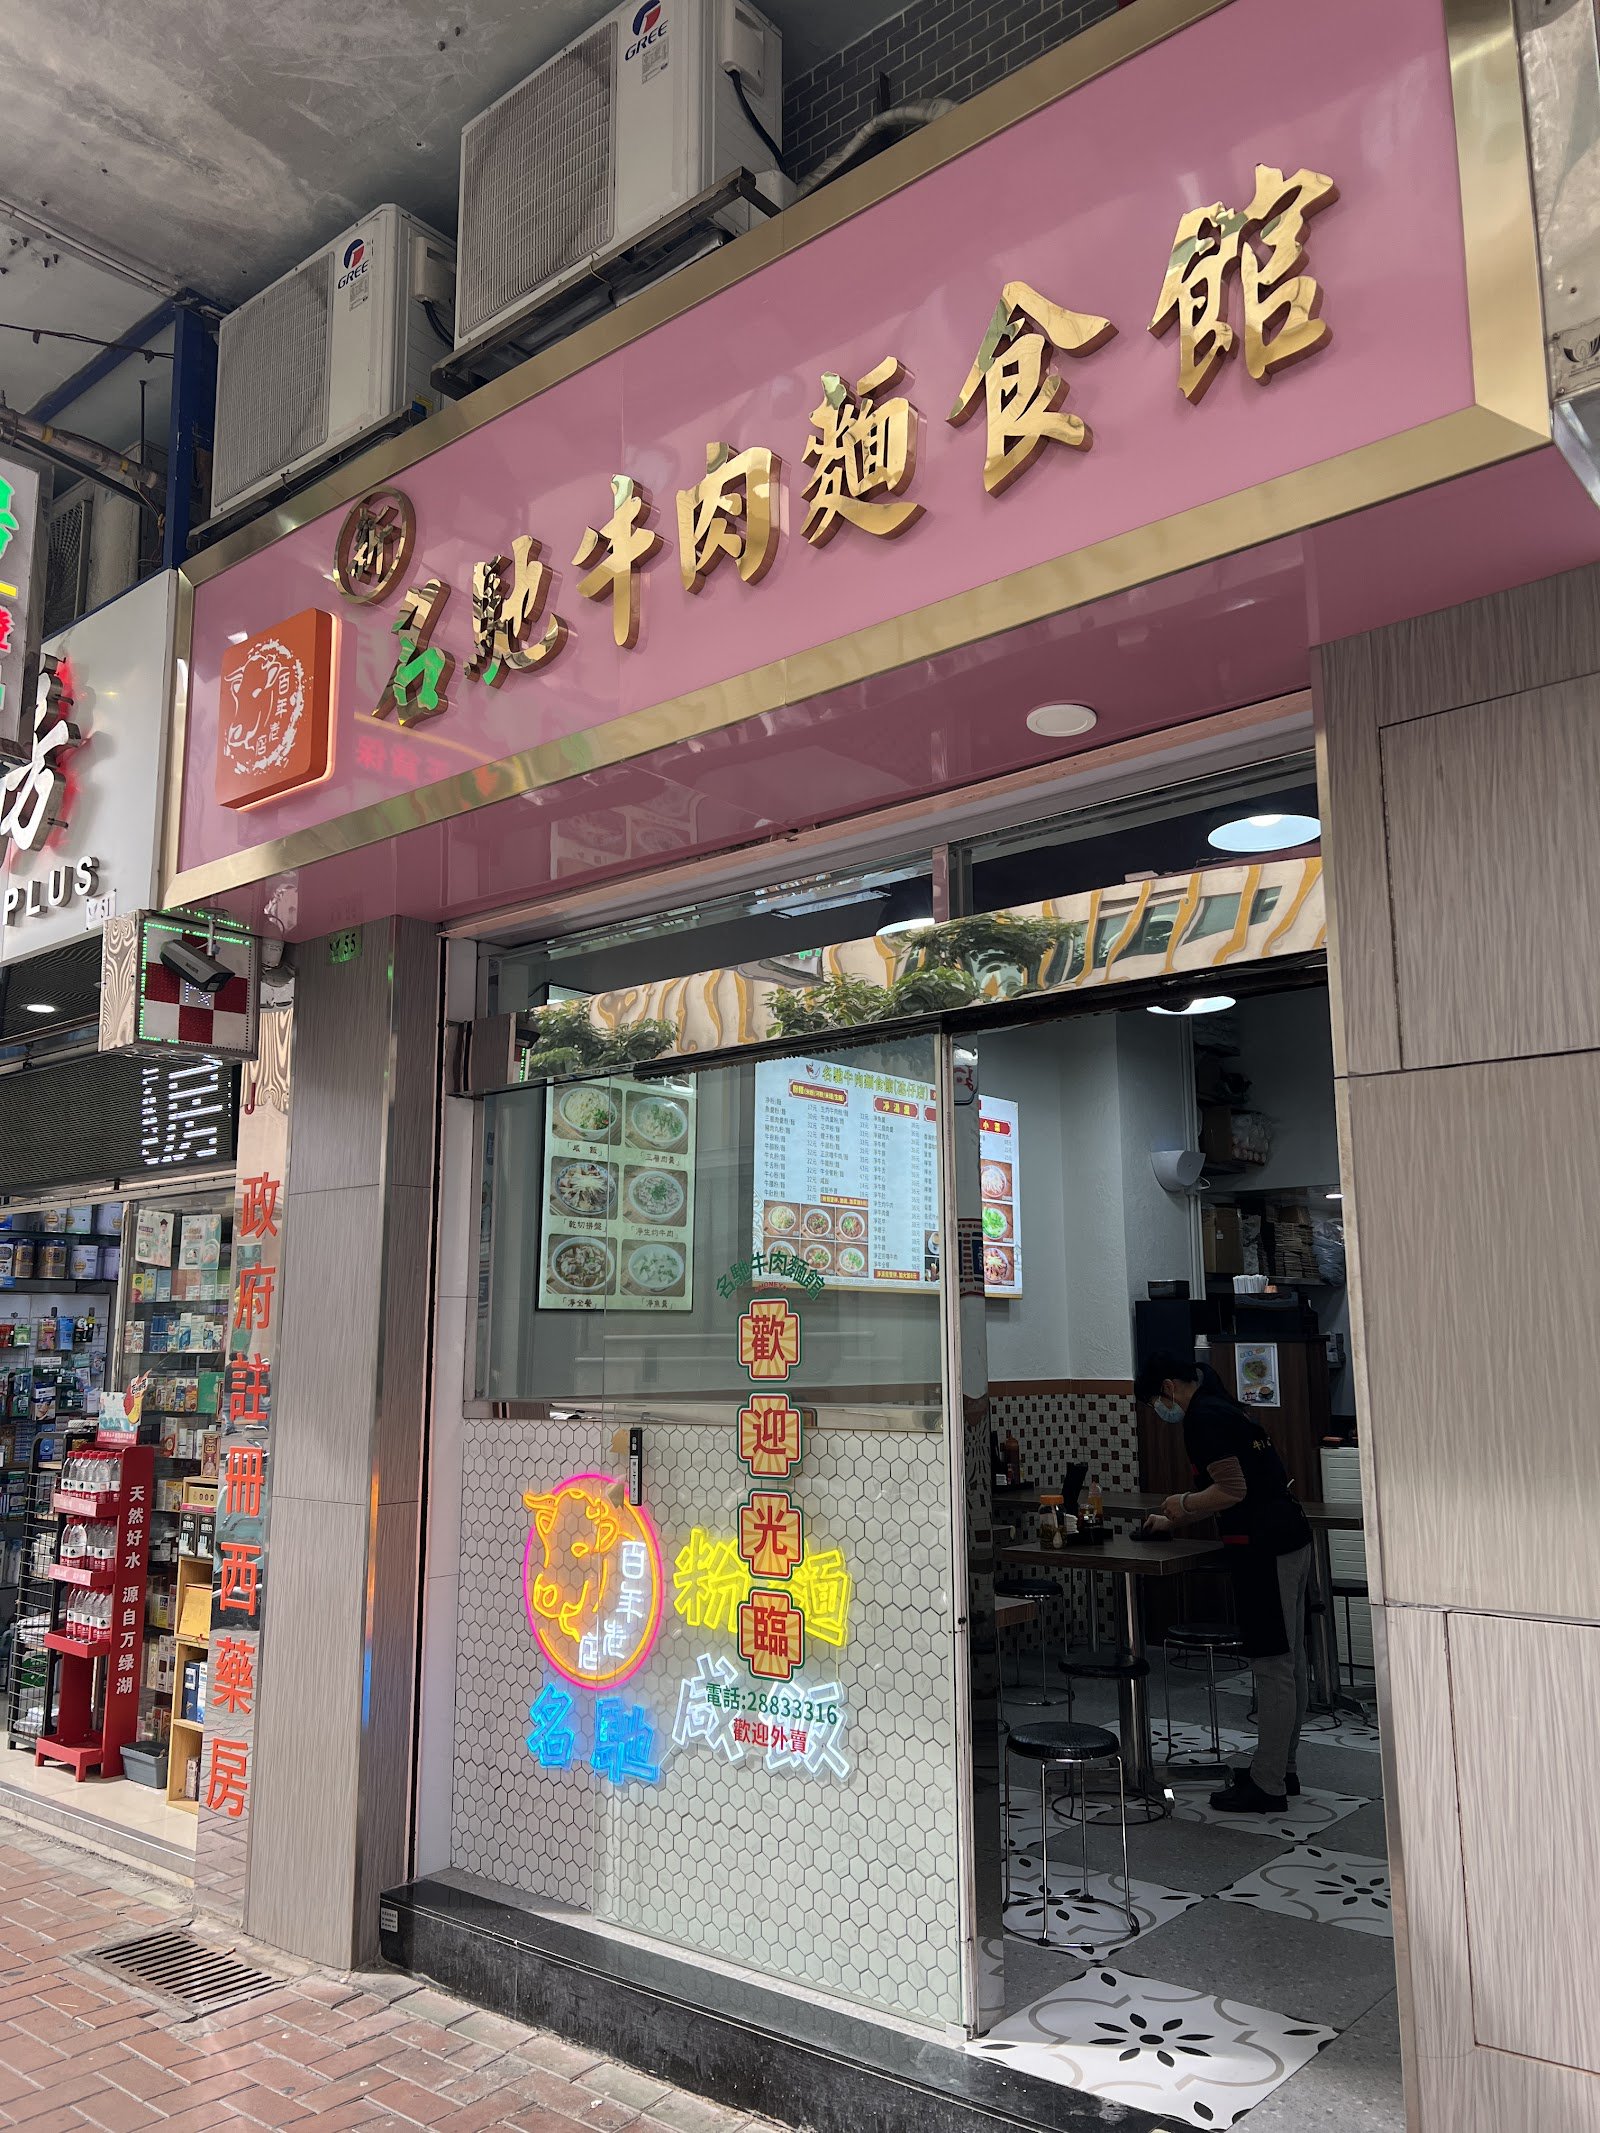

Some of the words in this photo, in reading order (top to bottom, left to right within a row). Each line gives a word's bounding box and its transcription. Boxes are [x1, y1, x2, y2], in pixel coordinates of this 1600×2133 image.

[625, 20, 668, 61] GREE
[338, 259, 369, 289] GREE
[3, 856, 99, 926] PLUS
[716, 1251, 826, 1300] 名馳牛肉麵館
[205, 1170, 280, 1818] 政府註冊西藥房
[751, 1314, 790, 1657] 歡迎光臨
[124, 1485, 146, 1570] 天然好水
[116, 1585, 140, 1695] 源自万绿湖
[525, 1682, 661, 1785] 名馳
[705, 1682, 838, 1726] 電話:28833316
[732, 1717, 808, 1755] 歡迎外賣
